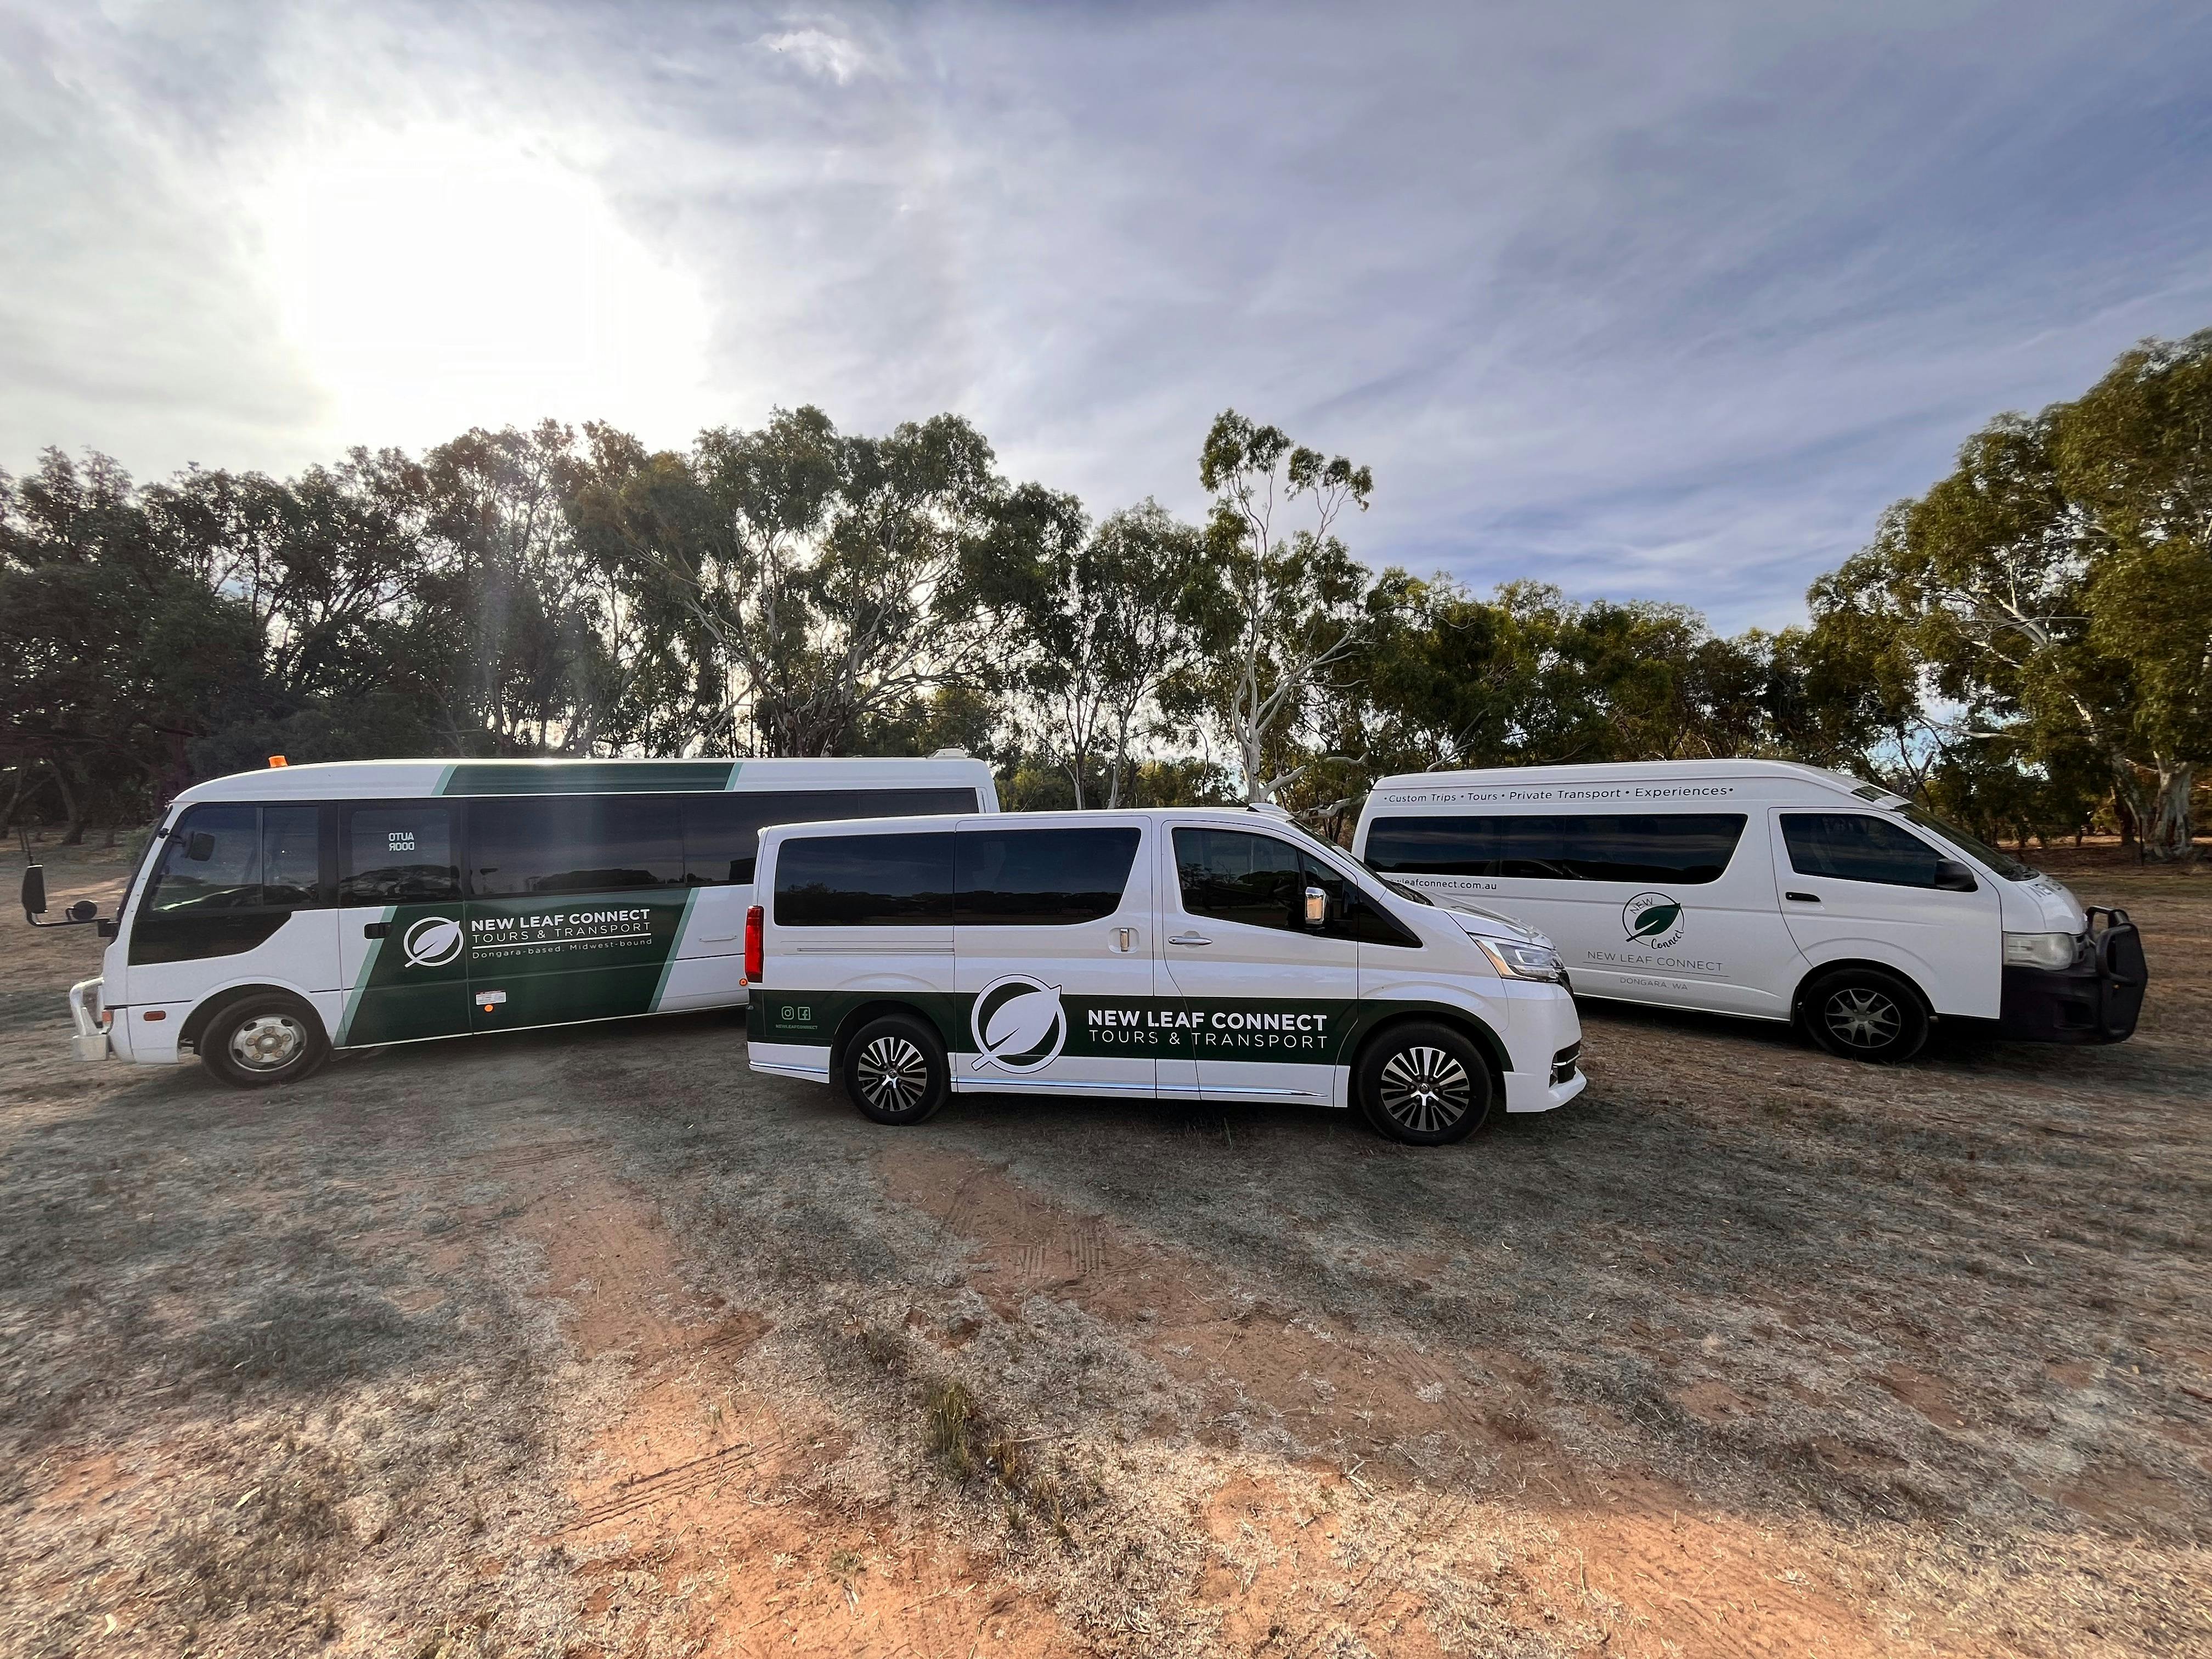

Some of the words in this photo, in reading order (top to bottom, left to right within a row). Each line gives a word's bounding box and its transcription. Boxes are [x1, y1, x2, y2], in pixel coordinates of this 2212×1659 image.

[1389, 794, 1426, 803] Custom
[1431, 794, 1456, 803] Trips
[1510, 791, 1552, 799] Private
[1558, 789, 1621, 799] Transport
[1635, 787, 1728, 798] Experiences
[1629, 897, 1653, 915] NEW
[471, 918, 515, 932] NEW
[520, 914, 565, 928] LEAF
[568, 909, 650, 925] CONNECT
[472, 931, 529, 943] TOURS
[537, 930, 545, 939] &
[554, 922, 650, 938] TRANSPORT
[1651, 929, 1684, 950] Connect
[472, 945, 565, 959] Dongara-based.
[569, 938, 652, 951] Midwest-bound
[1588, 951, 1616, 961] NEW
[1620, 954, 1653, 964] LEAF
[1657, 957, 1723, 971] CONNECT
[1088, 1009, 1140, 1026] NEW
[1147, 1011, 1205, 1028] LEAF
[1211, 1012, 1328, 1031] CONNECT
[1089, 1030, 1158, 1044] TOURS
[1169, 1032, 1180, 1045] &
[1191, 1032, 1328, 1048] TRANSPORT
